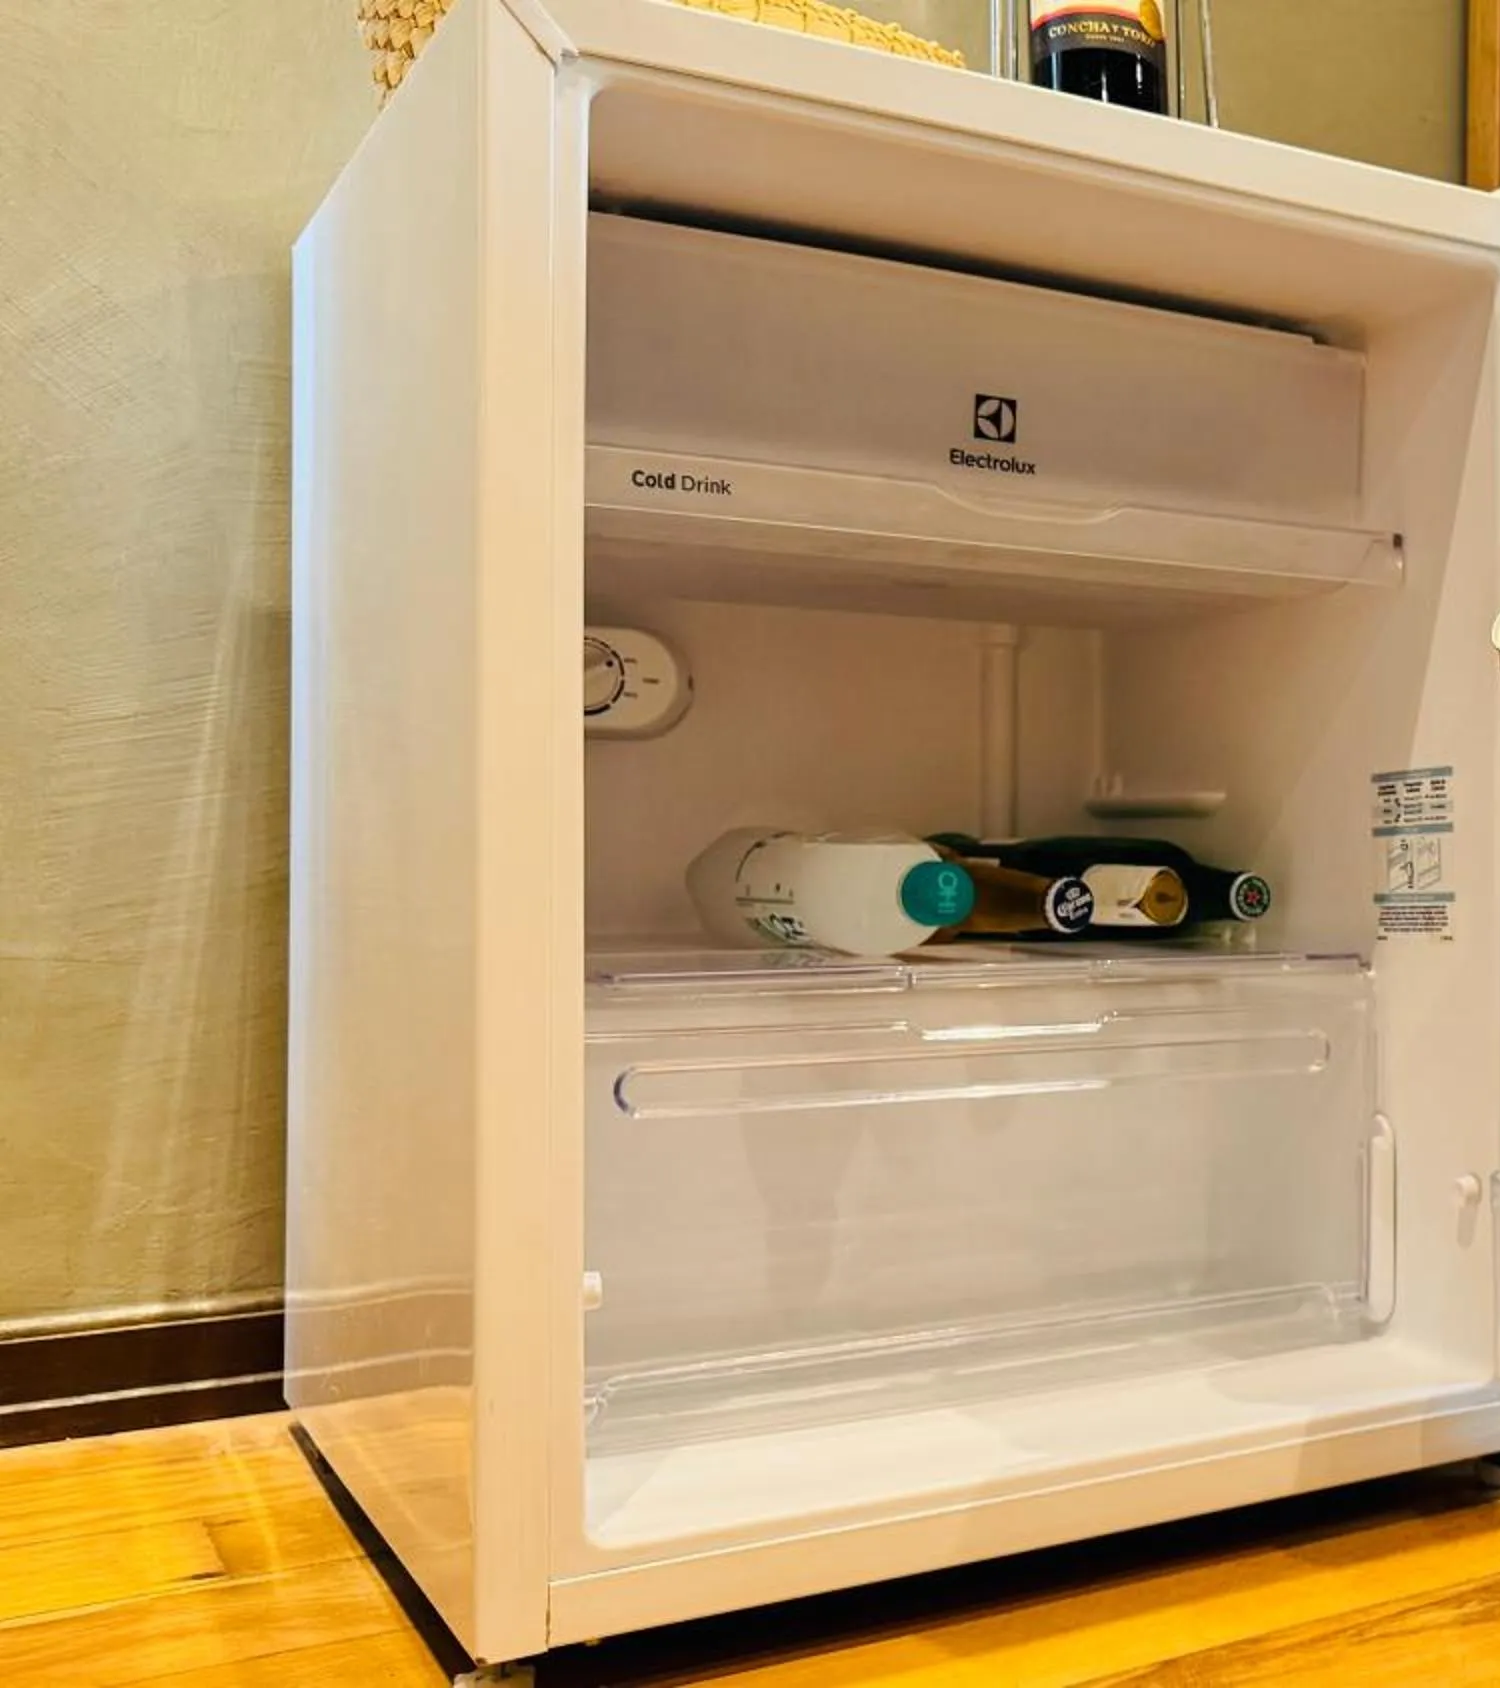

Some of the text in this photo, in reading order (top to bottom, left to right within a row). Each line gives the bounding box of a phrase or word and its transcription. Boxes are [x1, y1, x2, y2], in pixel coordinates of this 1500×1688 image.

[1048, 20, 1110, 38] CONCHA
[949, 448, 1036, 475] Electrolux
[631, 469, 732, 496] Cold Drink
